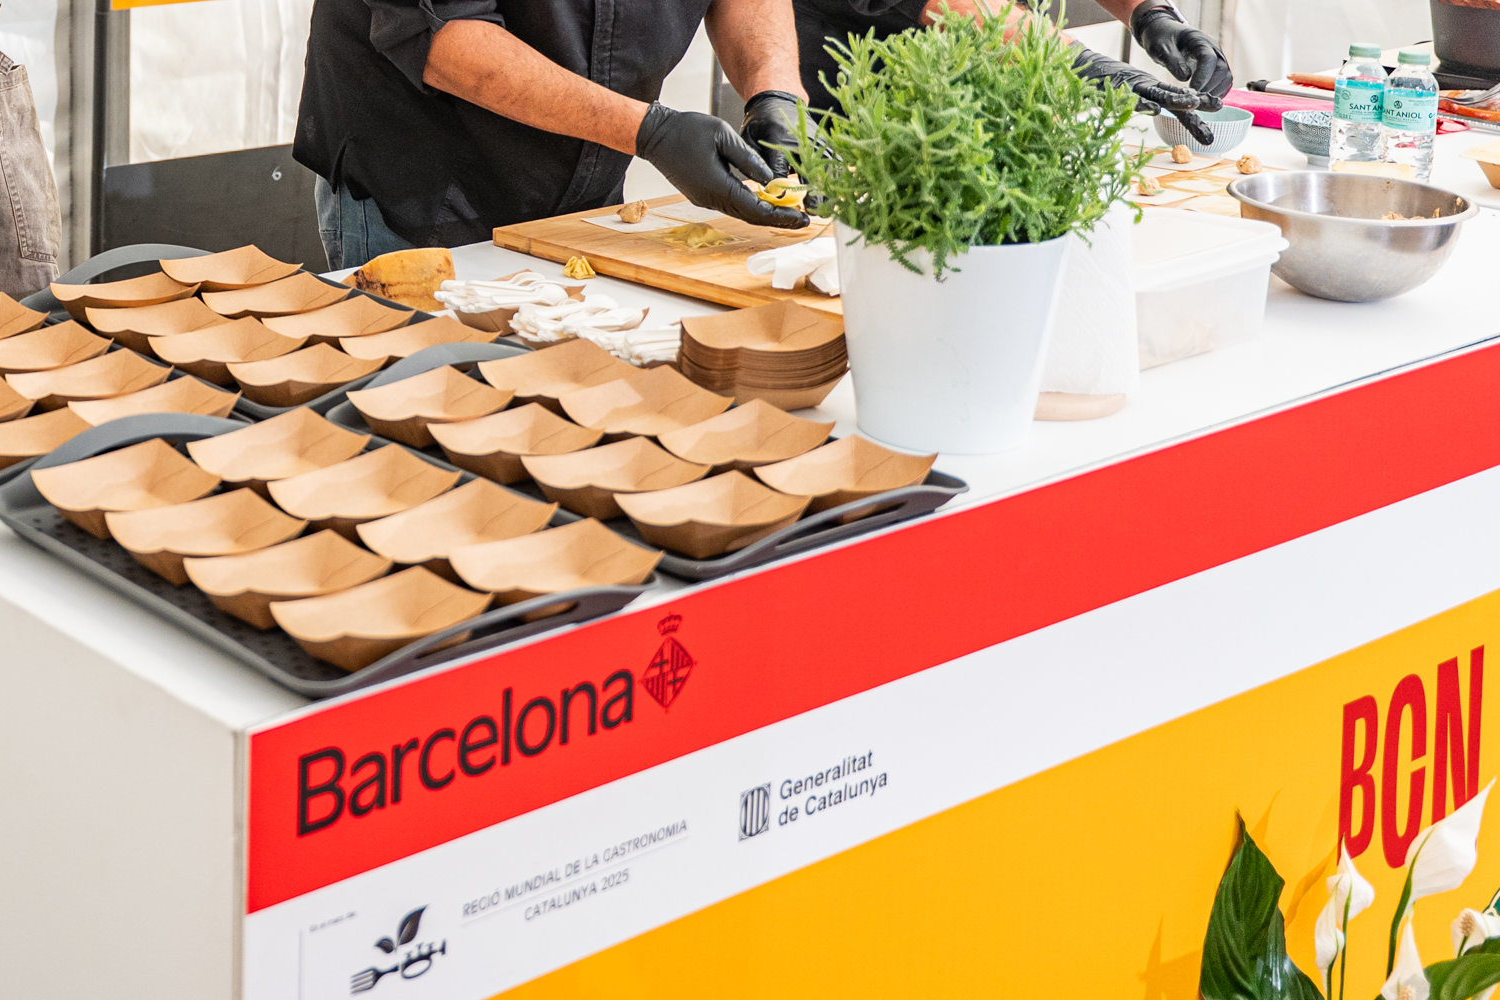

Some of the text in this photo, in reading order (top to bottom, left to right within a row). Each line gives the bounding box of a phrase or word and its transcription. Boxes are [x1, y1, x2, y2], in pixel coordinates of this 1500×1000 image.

[1349, 102, 1371, 111] SANT
[1395, 111, 1422, 120] ANIOL
[296, 668, 635, 838] Barcelona
[778, 749, 875, 802] Generalitat
[1336, 644, 1485, 869] BCN
[777, 770, 889, 828] de Catalunya
[462, 818, 689, 918] REGIÓ MUNDIAL DE LA GASTRONOMIA
[523, 868, 630, 923] CATALUNYA 2025
